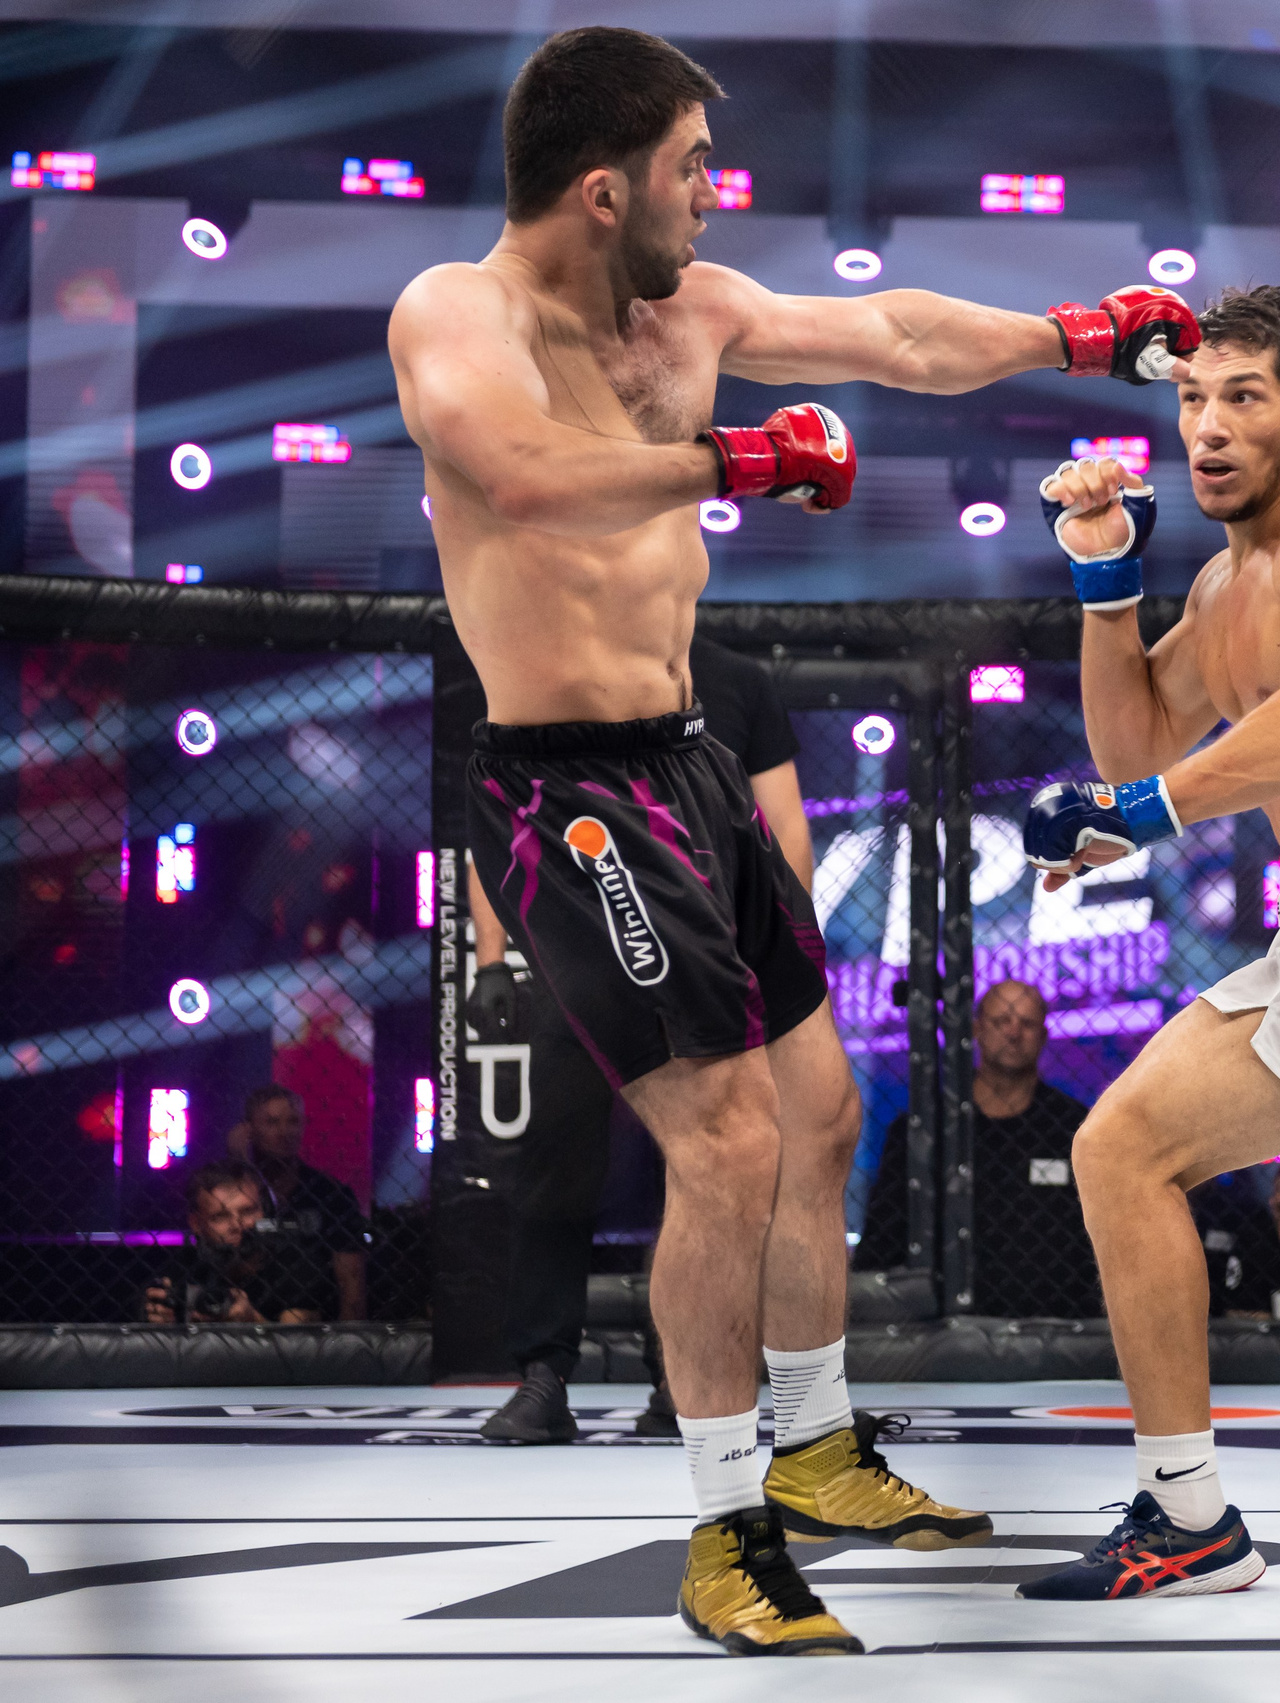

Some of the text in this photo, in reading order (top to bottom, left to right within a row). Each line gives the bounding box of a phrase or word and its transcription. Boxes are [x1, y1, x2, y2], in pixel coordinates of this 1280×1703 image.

[439, 848, 458, 1141] NEW LEVEL PRODUCTION
